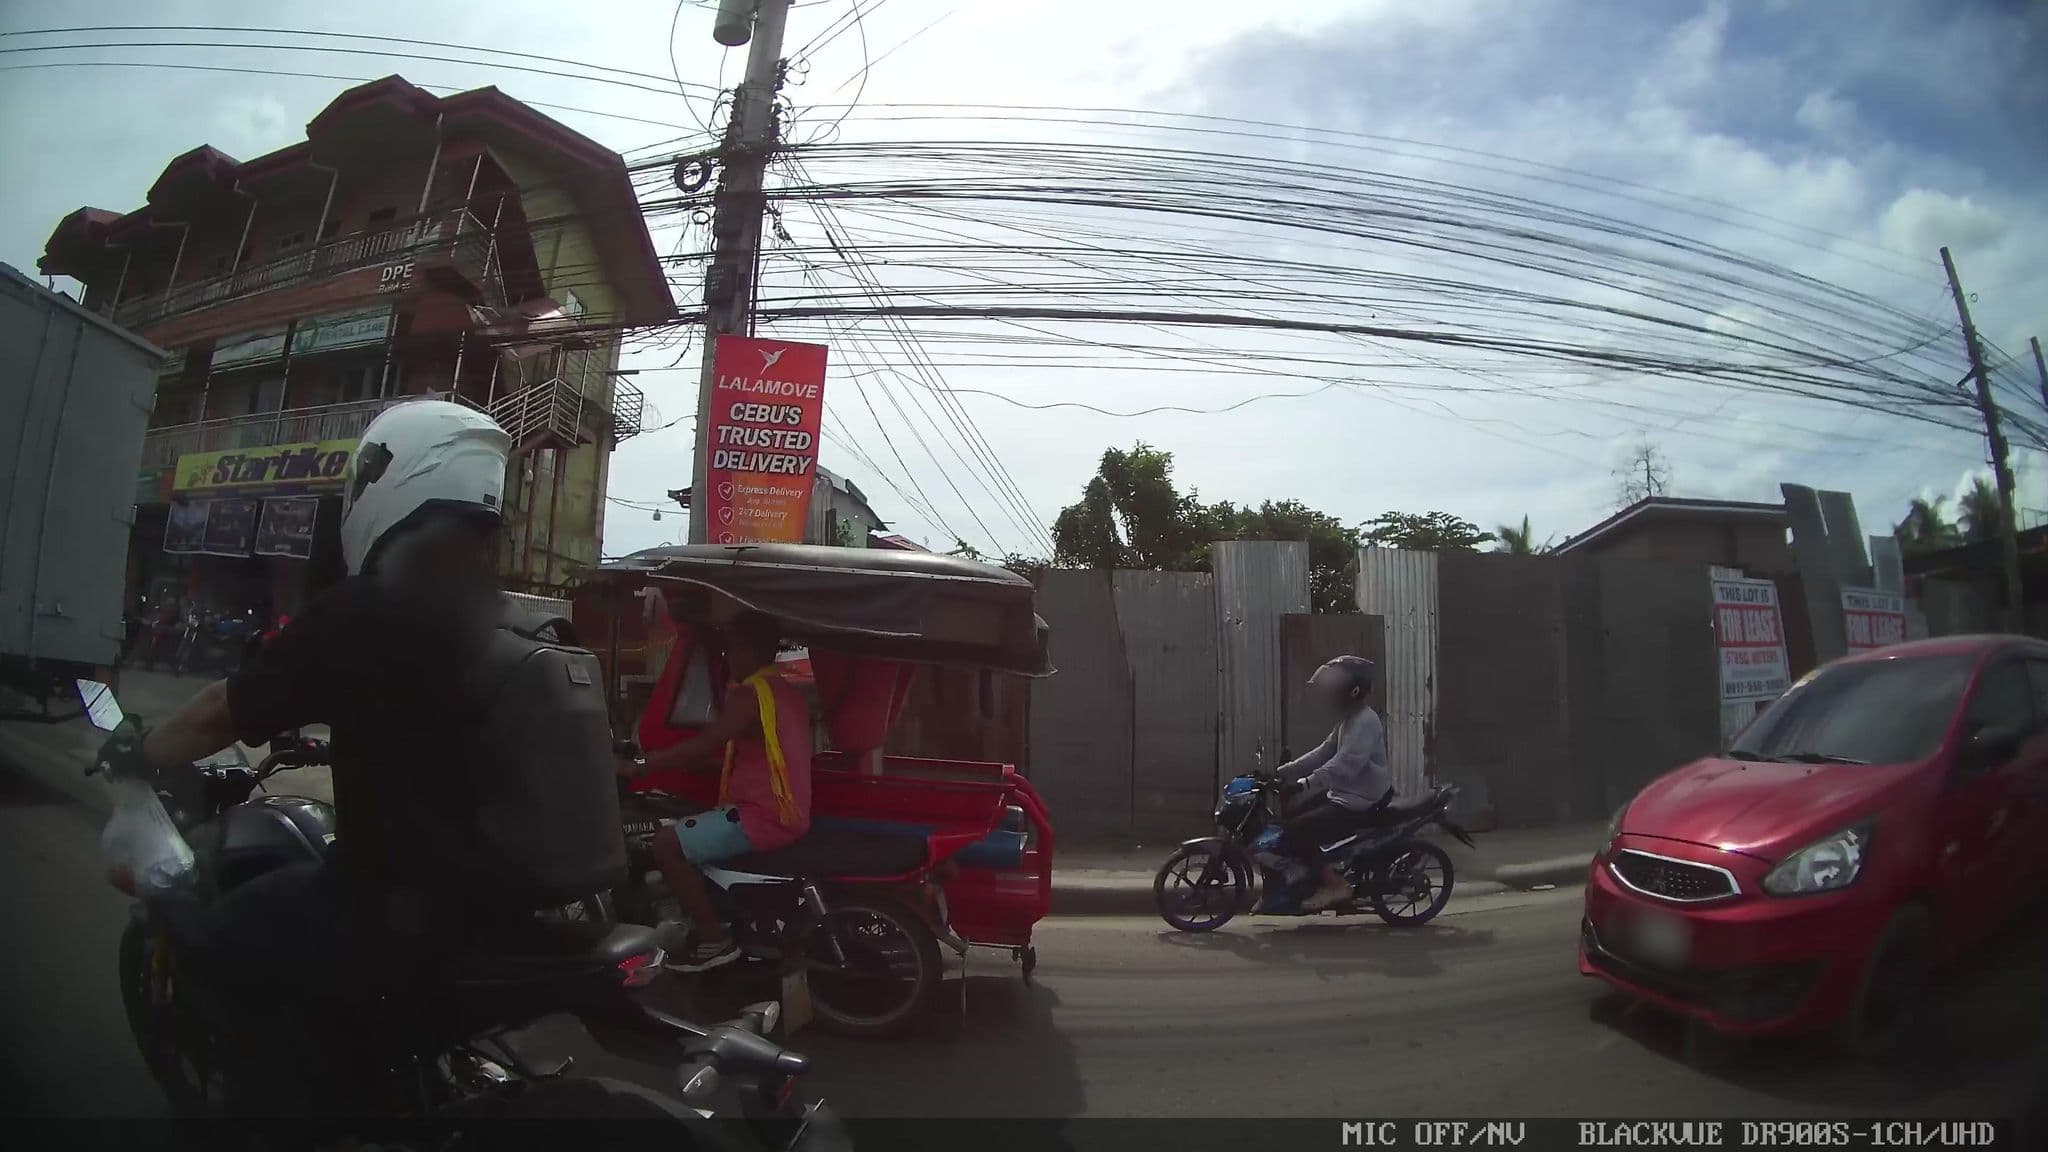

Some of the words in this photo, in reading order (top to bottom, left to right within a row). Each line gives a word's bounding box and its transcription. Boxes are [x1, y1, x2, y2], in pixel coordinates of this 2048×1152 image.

[381, 262, 415, 282] DPE
[718, 375, 819, 399] LALAMOVE
[729, 402, 803, 425] CEBU'S
[717, 425, 812, 450] TRUSTED
[212, 447, 350, 485] Starbike
[713, 449, 813, 475] DELIVERY
[737, 485, 769, 497] Express
[769, 486, 804, 499] Delivery
[754, 508, 788, 521] Delivery
[1719, 586, 1741, 601] THIS
[1743, 587, 1759, 602] LOT
[1720, 607, 1743, 641] FOR
[1743, 608, 1778, 641] LEASE
